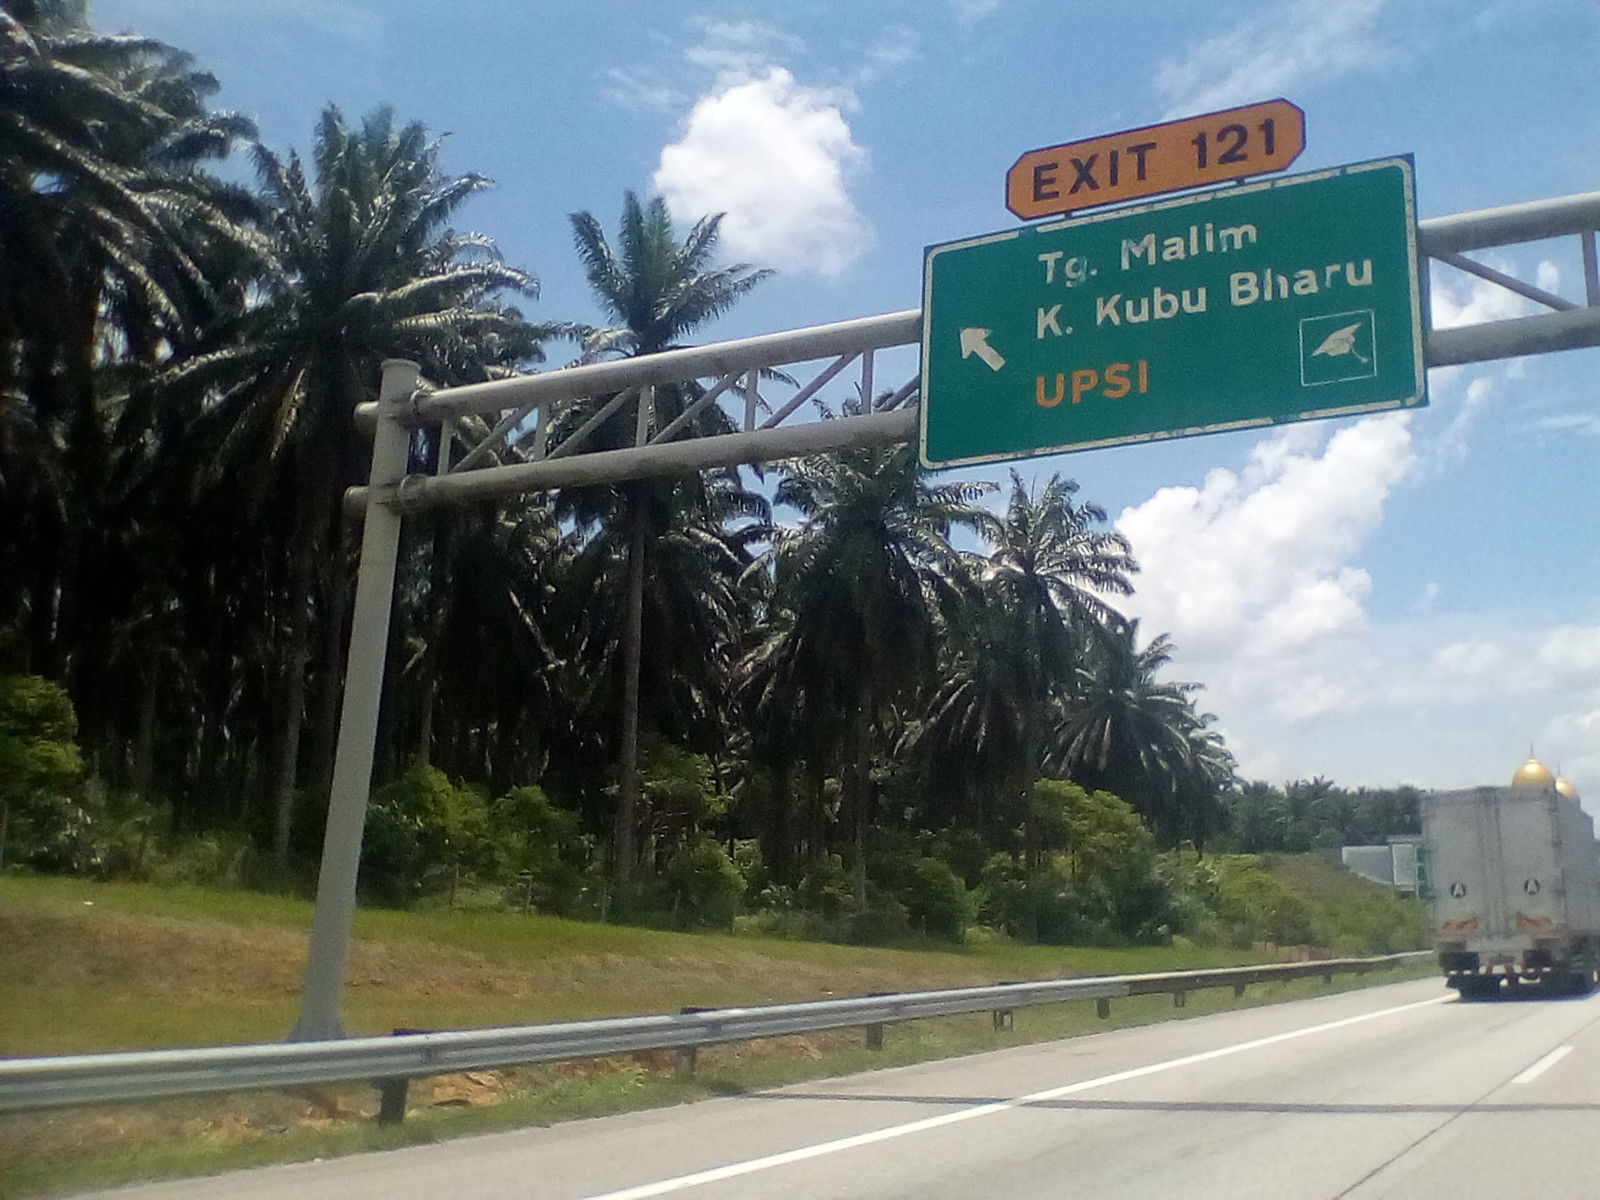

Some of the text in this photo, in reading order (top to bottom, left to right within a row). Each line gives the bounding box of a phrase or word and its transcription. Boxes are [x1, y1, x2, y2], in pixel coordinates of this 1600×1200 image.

[1032, 117, 1276, 202] EXIT 121
[1120, 222, 1258, 271] Malim
[1036, 258, 1374, 339] K. Kubu Bharu
[1036, 360, 1150, 408] UPSI
